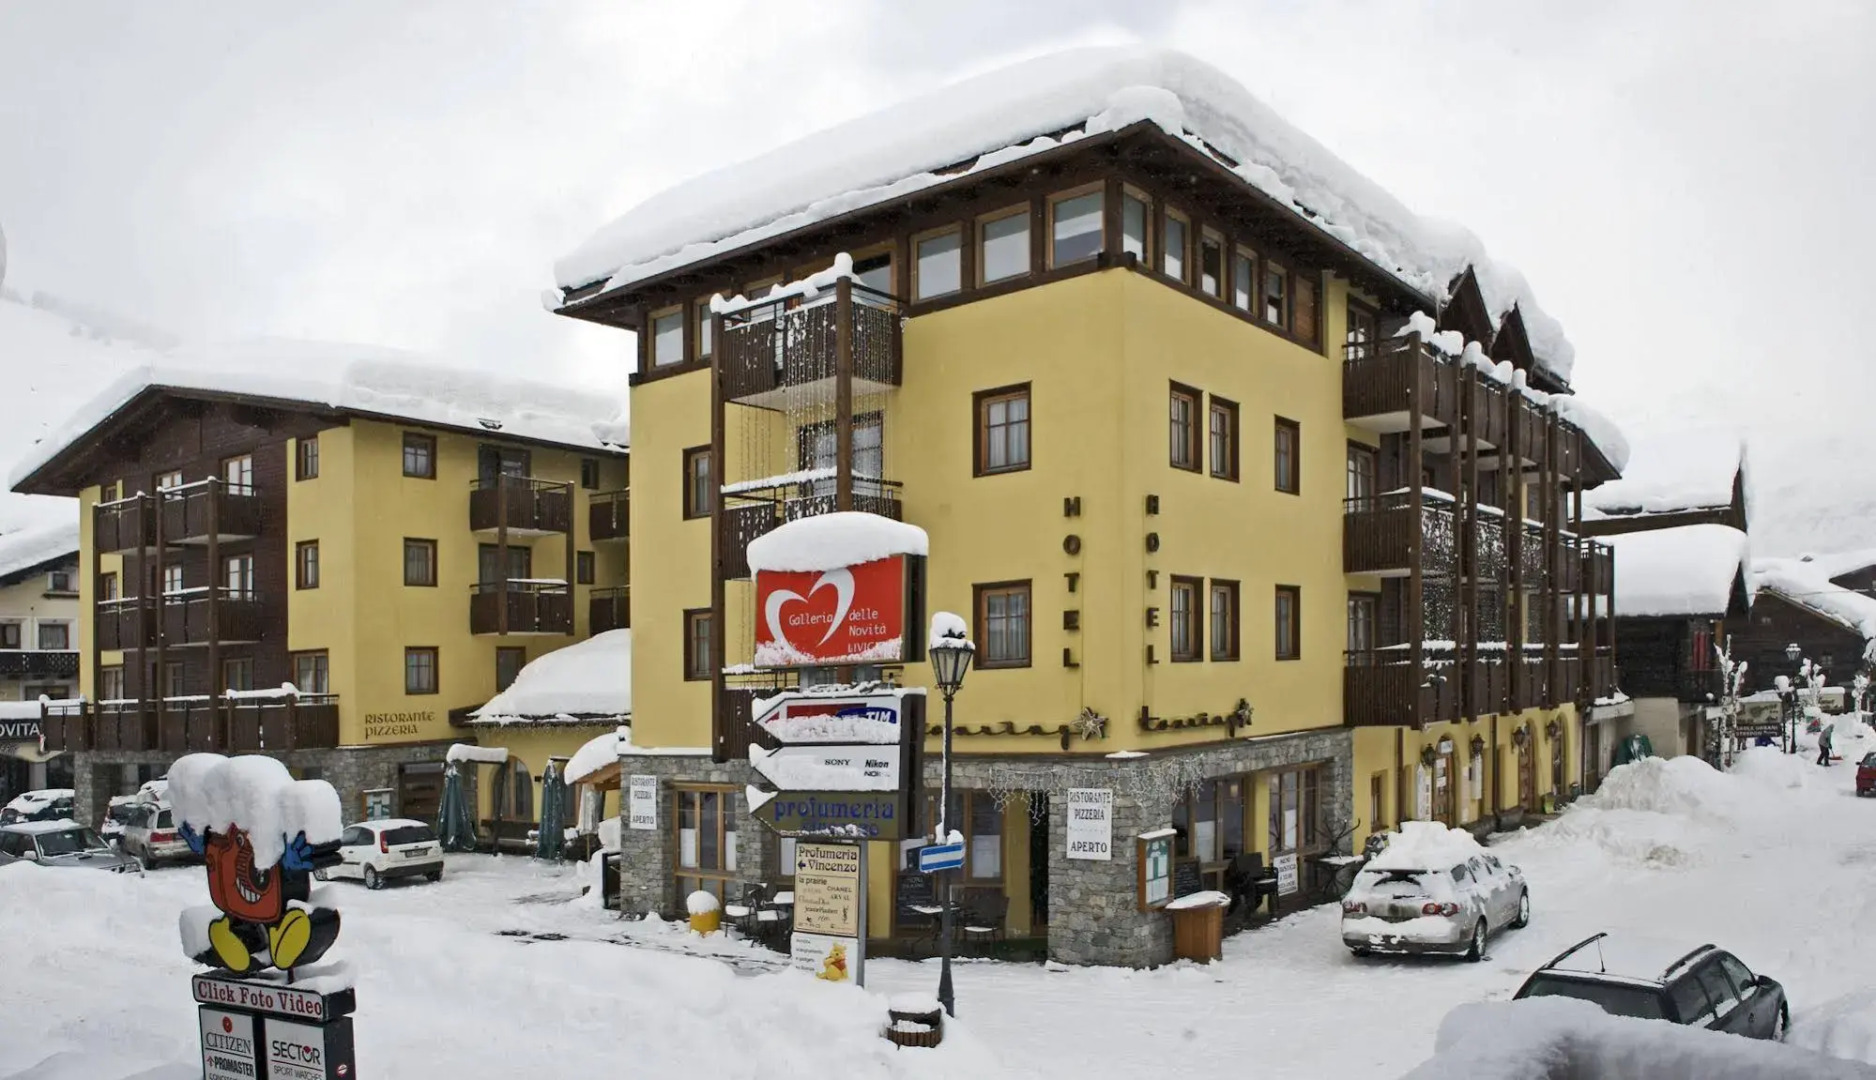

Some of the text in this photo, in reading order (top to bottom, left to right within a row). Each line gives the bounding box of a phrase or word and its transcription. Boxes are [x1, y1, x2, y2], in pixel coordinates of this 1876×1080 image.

[1063, 496, 1081, 668] HOTEL
[1145, 495, 1159, 665] HOTEL
[788, 608, 879, 626] Galleria delle
[848, 622, 887, 637] Novità
[364, 711, 436, 725] RISTORANTE
[866, 710, 891, 722] TIM
[364, 724, 419, 740] PIZZERIA
[864, 759, 889, 769] Nikon
[1069, 791, 1111, 805] RISTORANTE
[774, 797, 894, 821] profumeria
[1074, 808, 1105, 821] PIZZERIA
[798, 846, 858, 861] Profumeria
[1070, 841, 1108, 853] APERTO
[807, 859, 858, 873] Vincenzo
[826, 885, 853, 893] CHANEL
[197, 980, 323, 1016] Click Foto Video
[205, 1032, 252, 1054] CITIZEN
[272, 1040, 322, 1066] SECTOR
[213, 1055, 255, 1078] PROMASTER
[273, 1064, 293, 1077] SPORT
